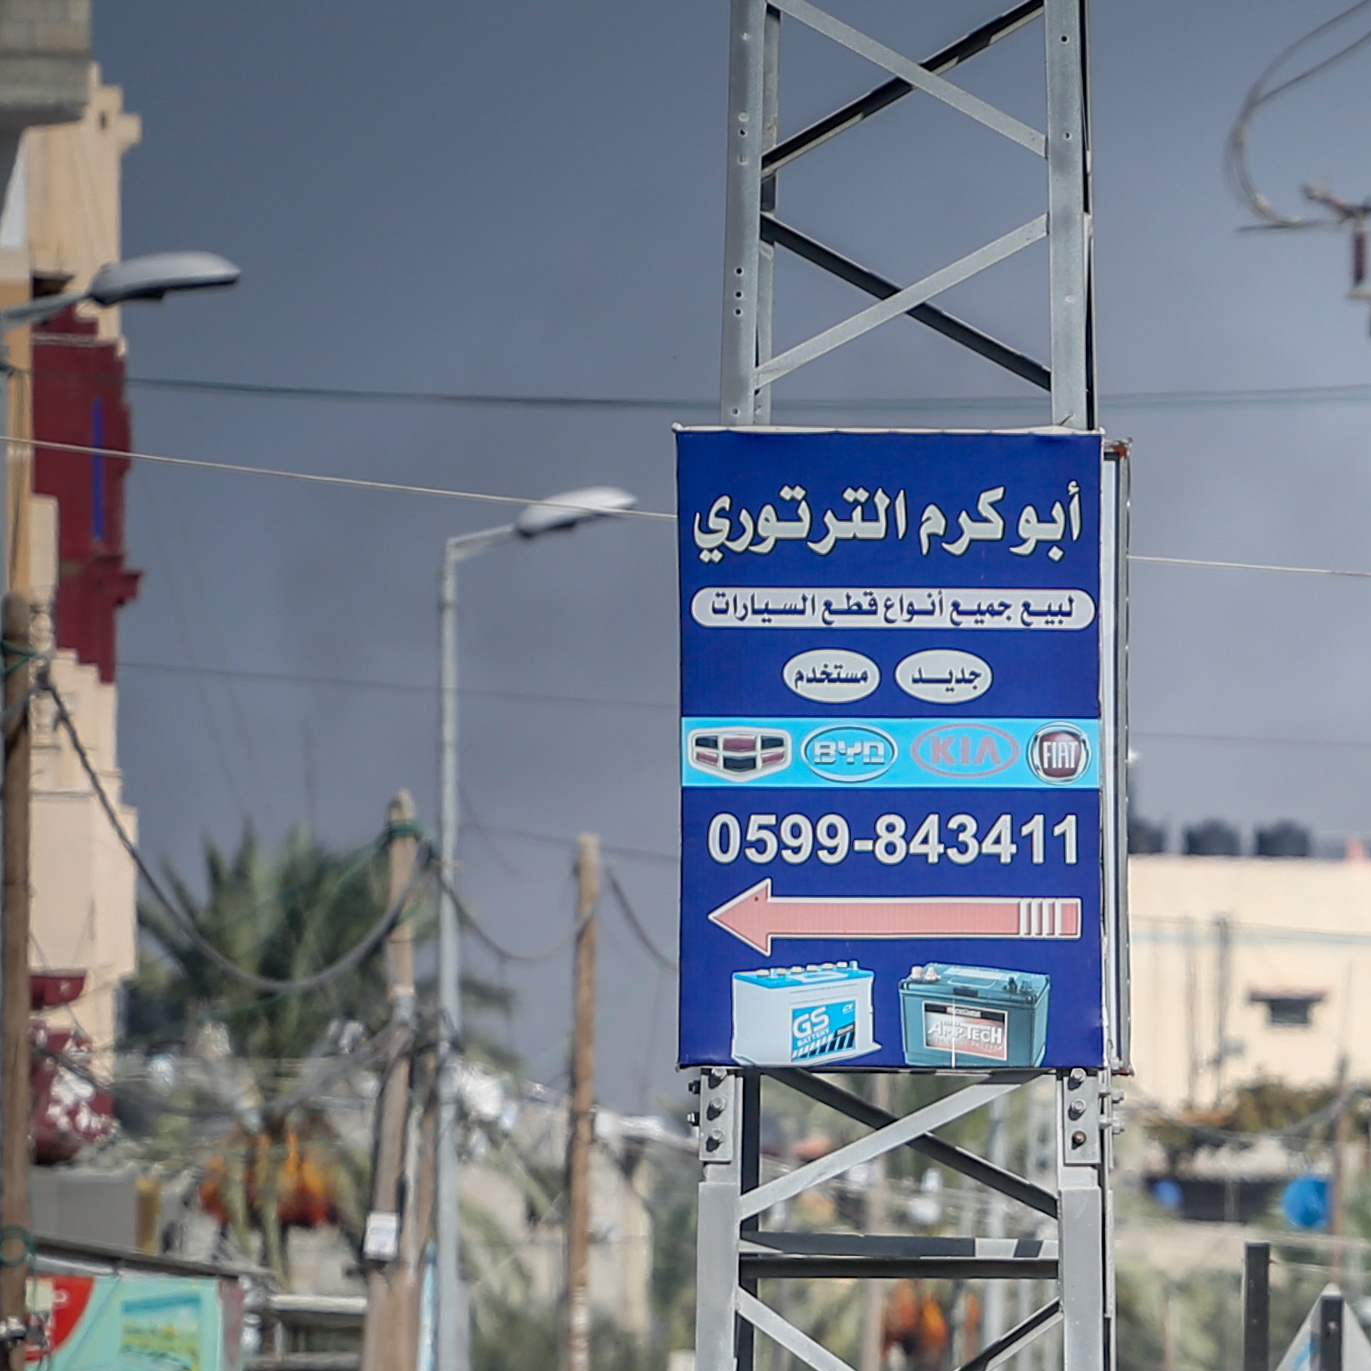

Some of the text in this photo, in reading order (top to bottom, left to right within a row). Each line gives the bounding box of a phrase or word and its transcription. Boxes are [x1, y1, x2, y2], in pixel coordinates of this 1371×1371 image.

[693, 480, 1082, 563] أبو كرم الترتوري
[711, 589, 1076, 627] لبيع جميع أنواع قطع السيارات
[794, 664, 982, 692] جديد مستخدم
[813, 737, 1080, 770] BYD KIA FIAT
[707, 813, 1079, 864] 0599-843411
[793, 1006, 830, 1039] GS
